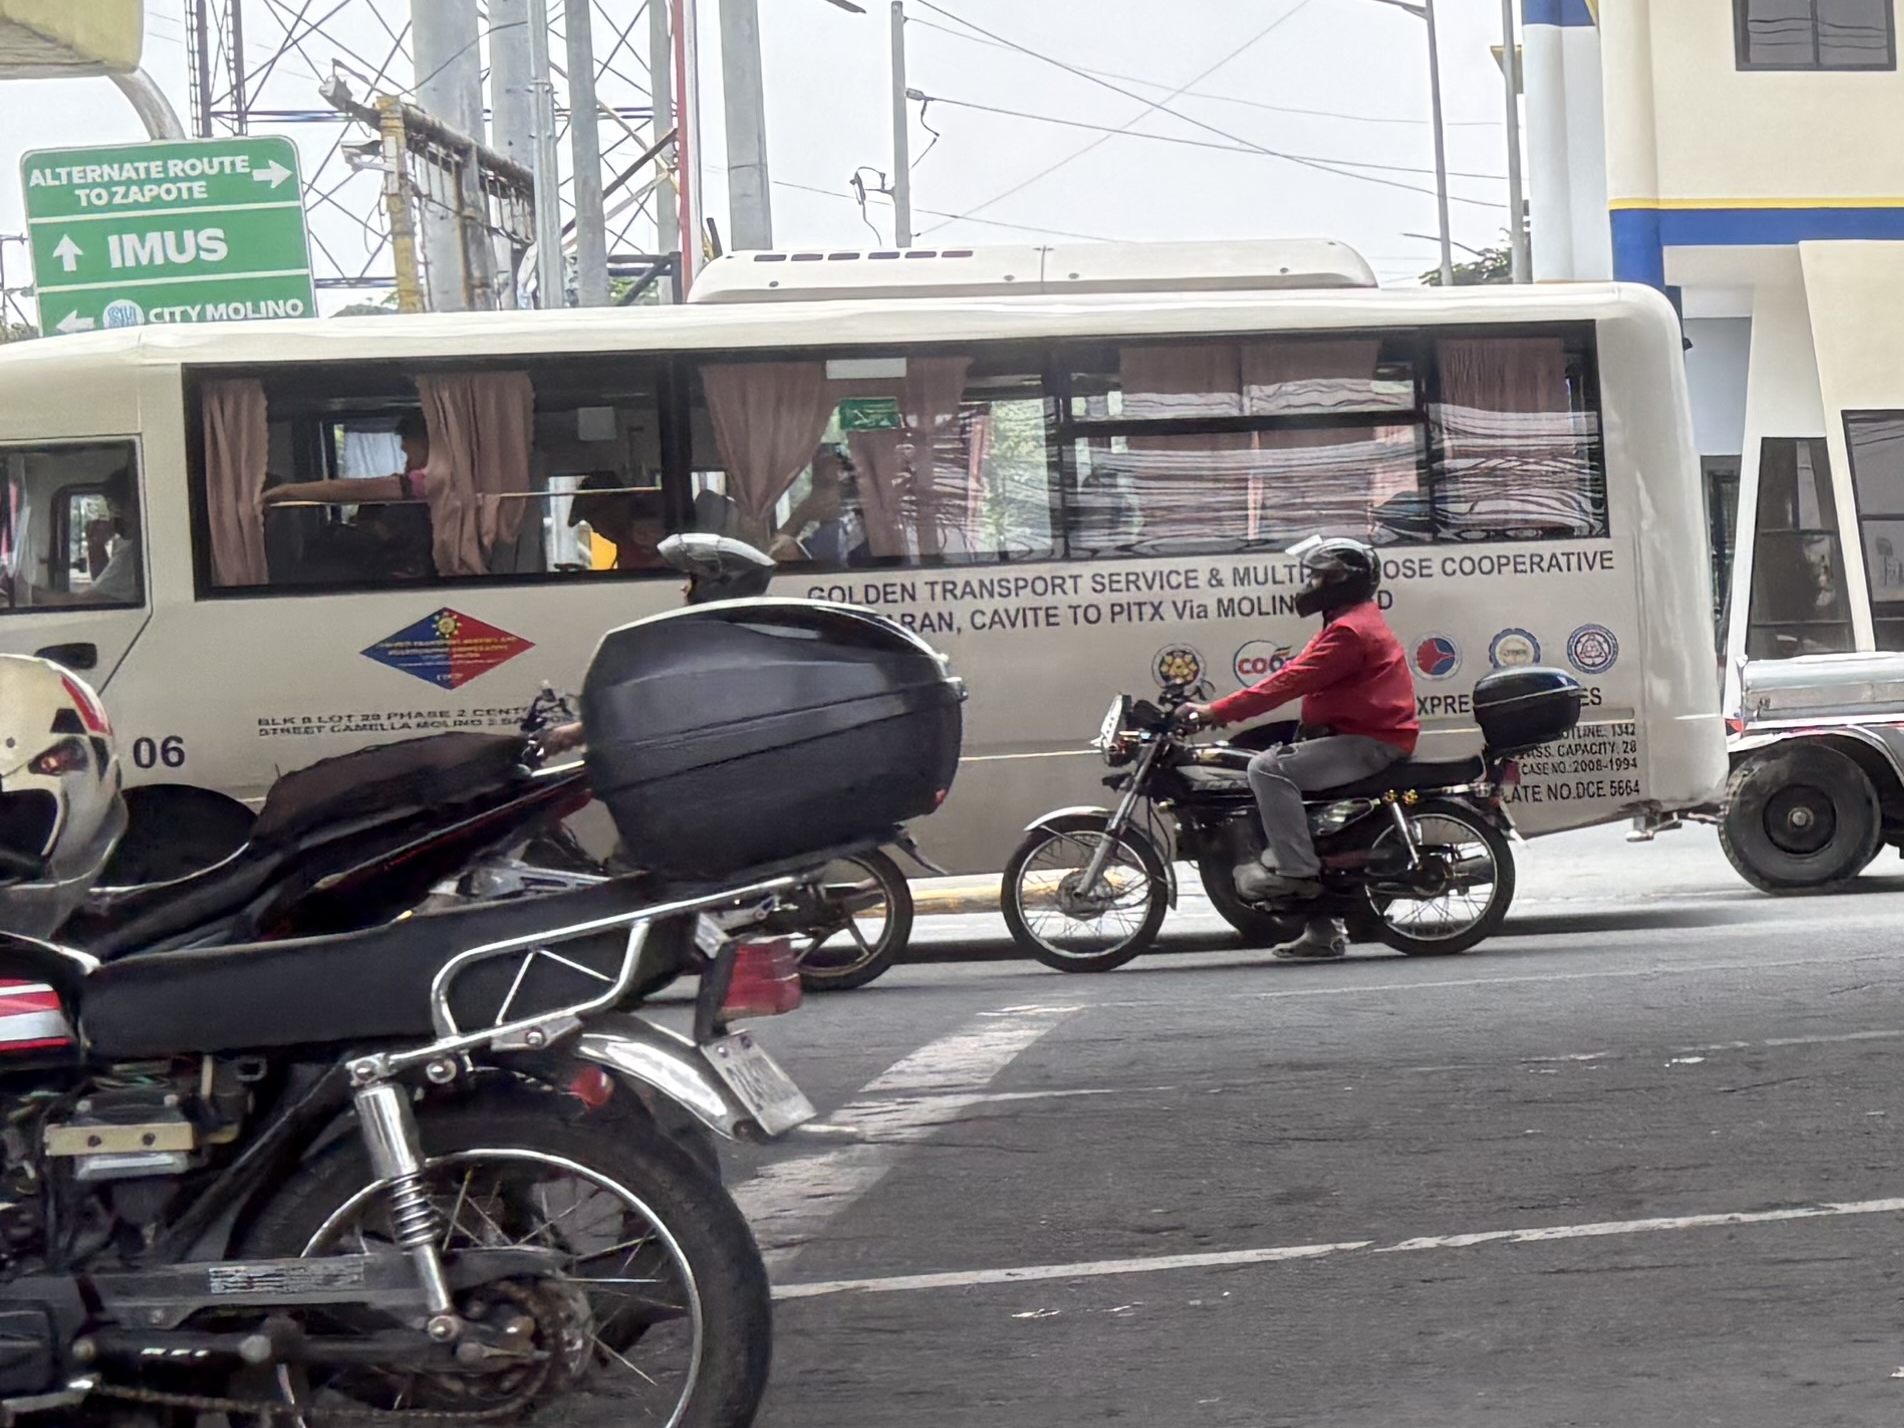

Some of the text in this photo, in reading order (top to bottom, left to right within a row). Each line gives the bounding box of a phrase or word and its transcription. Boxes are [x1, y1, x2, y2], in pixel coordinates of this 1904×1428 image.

[29, 155, 251, 187] ALTERNATE ROUTE
[74, 181, 208, 206] TO ZAPOTE
[107, 228, 229, 269] IMUS
[149, 305, 202, 323] CITY
[205, 298, 304, 321] MOLINO
[808, 582, 916, 605] GOLDEN
[925, 575, 1083, 601] TRANSPORT
[1091, 569, 1199, 594] SERVICE
[1207, 567, 1225, 588] &
[1440, 550, 1616, 577] COOPERATIVE
[970, 607, 1061, 632] CAVITE
[1068, 603, 1101, 626] TO
[1110, 599, 1164, 624] PITX
[1173, 598, 1208, 620] Via
[1217, 592, 1297, 618] MOLIN
[317, 714, 357, 724] LOT
[387, 710, 450, 721] PHASE
[132, 736, 186, 768] 06
